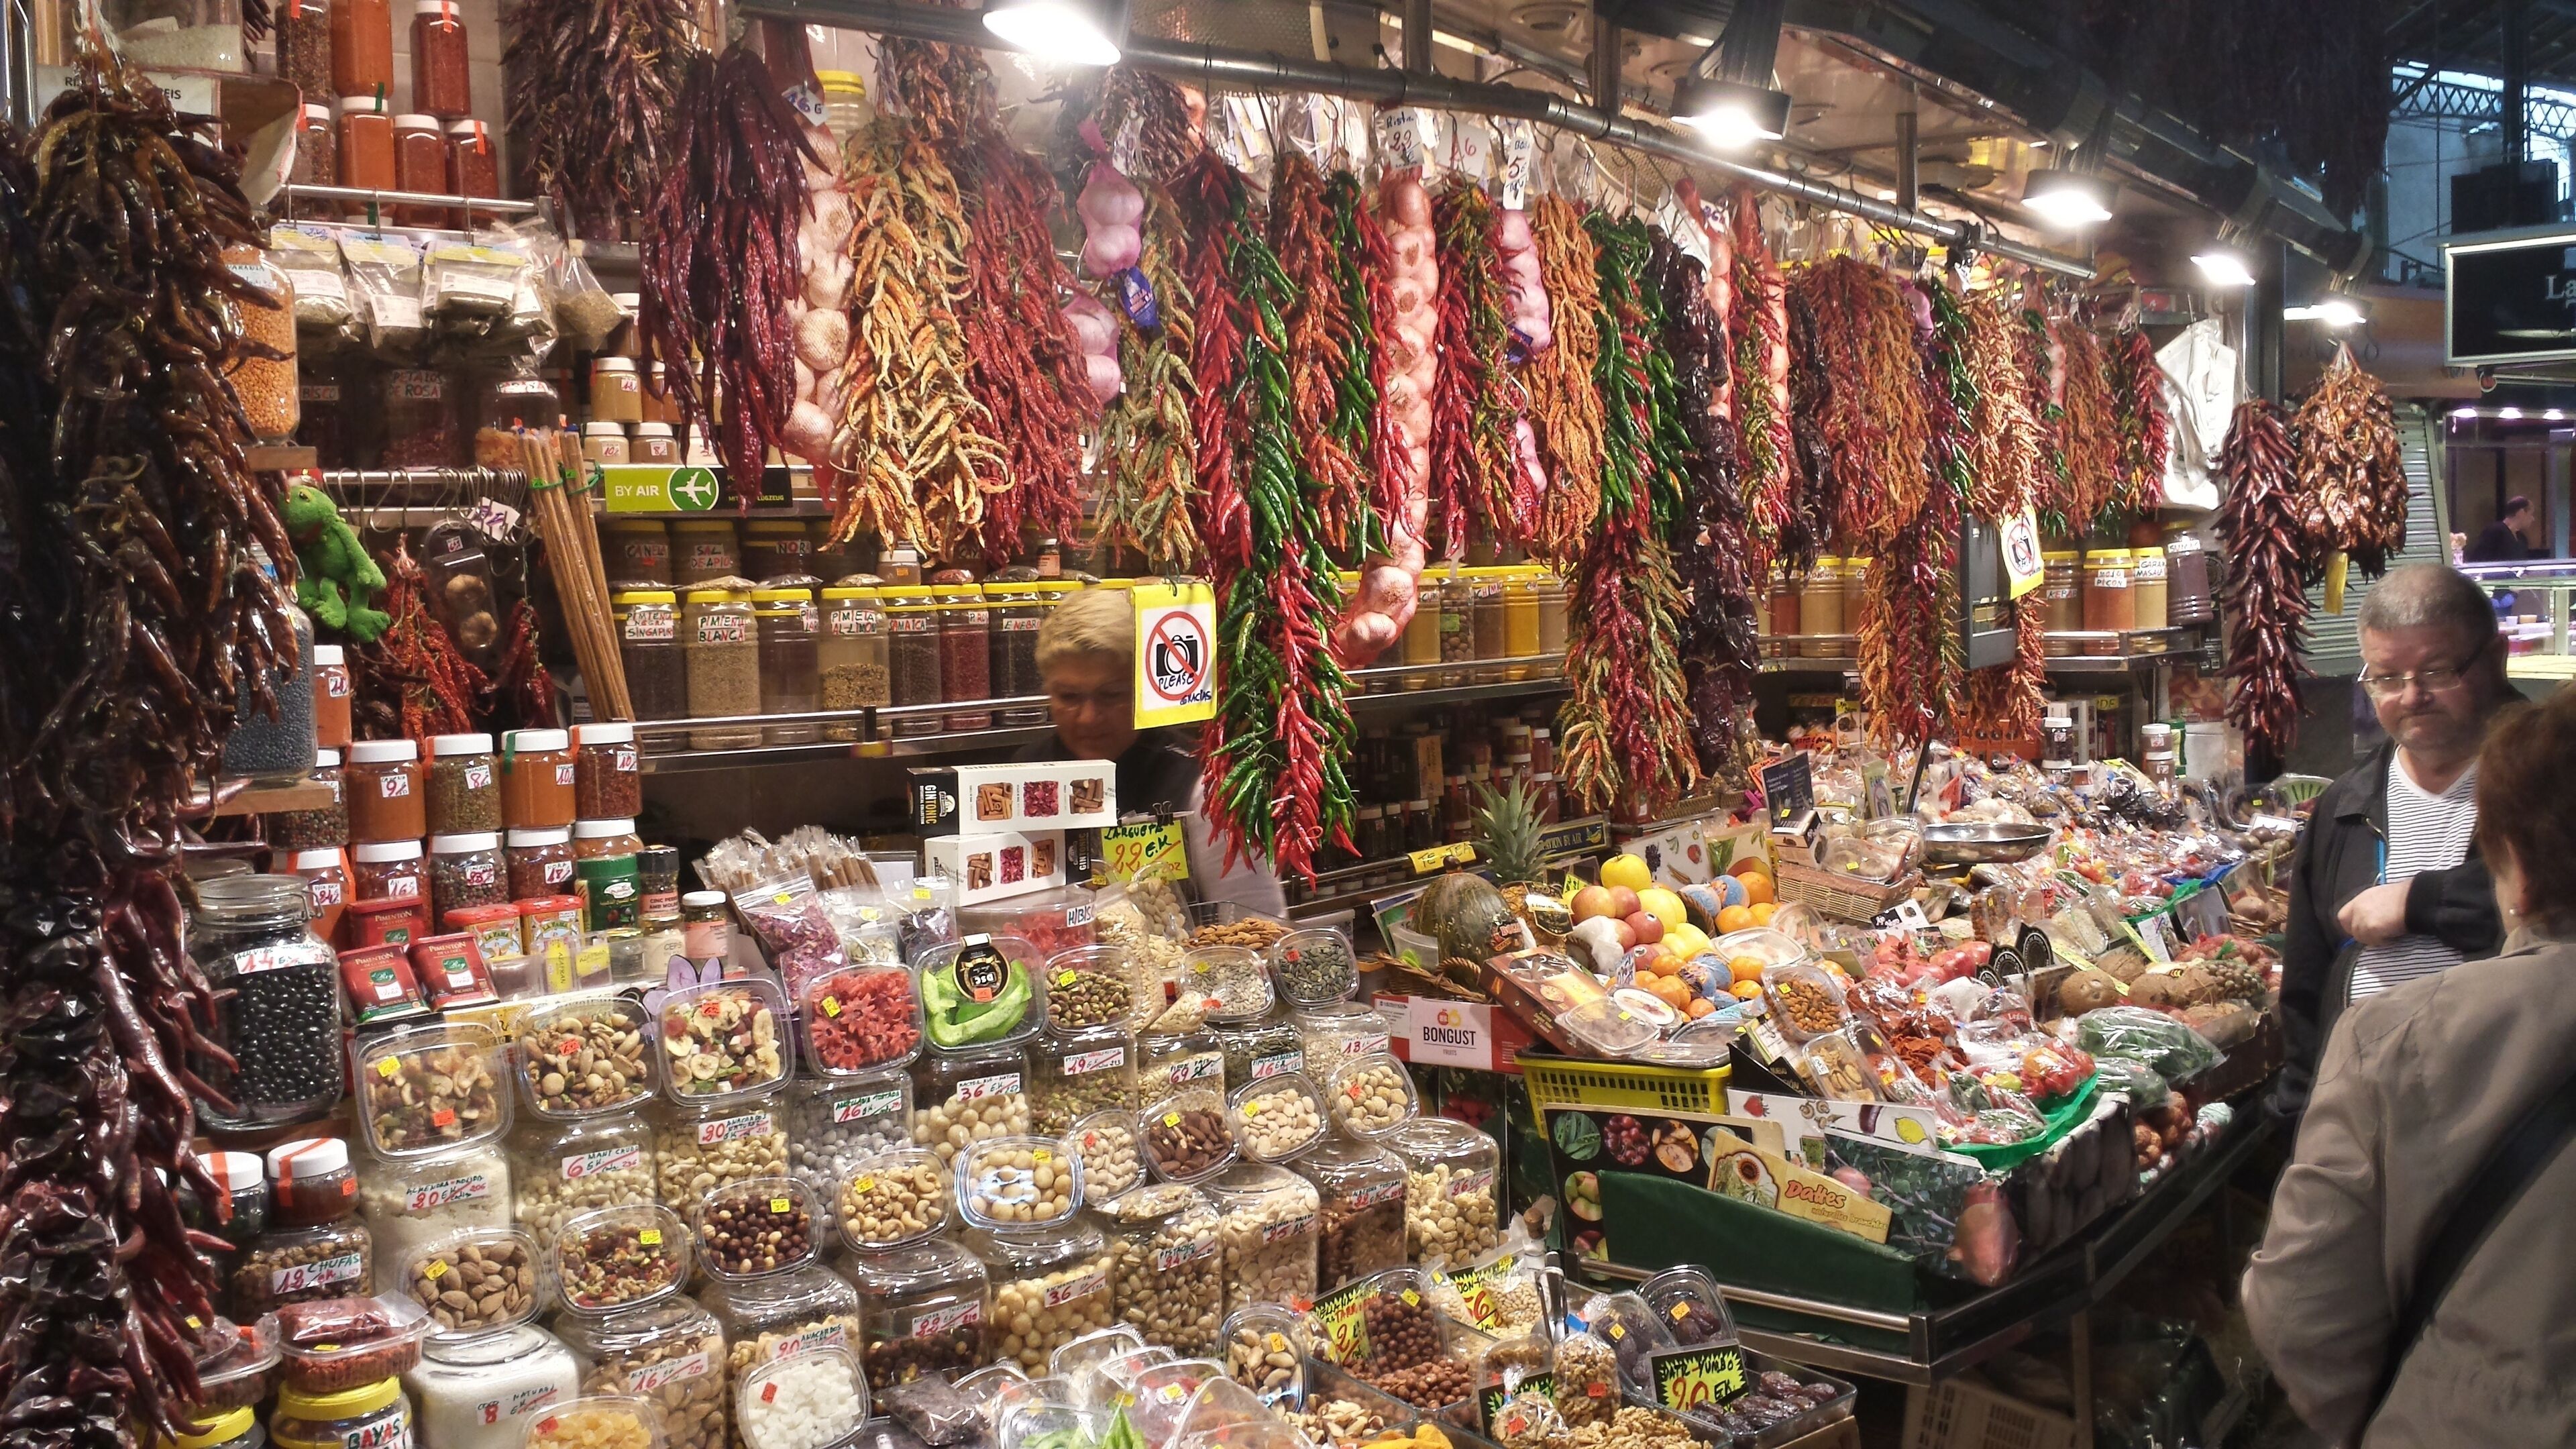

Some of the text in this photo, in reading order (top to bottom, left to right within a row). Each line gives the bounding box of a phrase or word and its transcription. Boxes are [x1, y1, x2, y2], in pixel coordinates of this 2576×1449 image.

[615, 486, 660, 497] BY AIR
[699, 631, 744, 643] BLANCA
[1159, 673, 1195, 692] PLEASE
[924, 785, 938, 824] GINTONIC
[429, 941, 467, 953] PIMENTON
[354, 952, 394, 965] PIMENTON
[1423, 1026, 1477, 1046] BONGUST
[1342, 1041, 1361, 1055] 13
[1171, 1067, 1189, 1084] 69
[961, 1083, 985, 1101] 36
[568, 1156, 585, 1177] 6
[1784, 1180, 1847, 1209] Dattes
[307, 1254, 360, 1273] CHUFAS
[1049, 1285, 1072, 1305] 36
[348, 1417, 401, 1449] BAYAS
